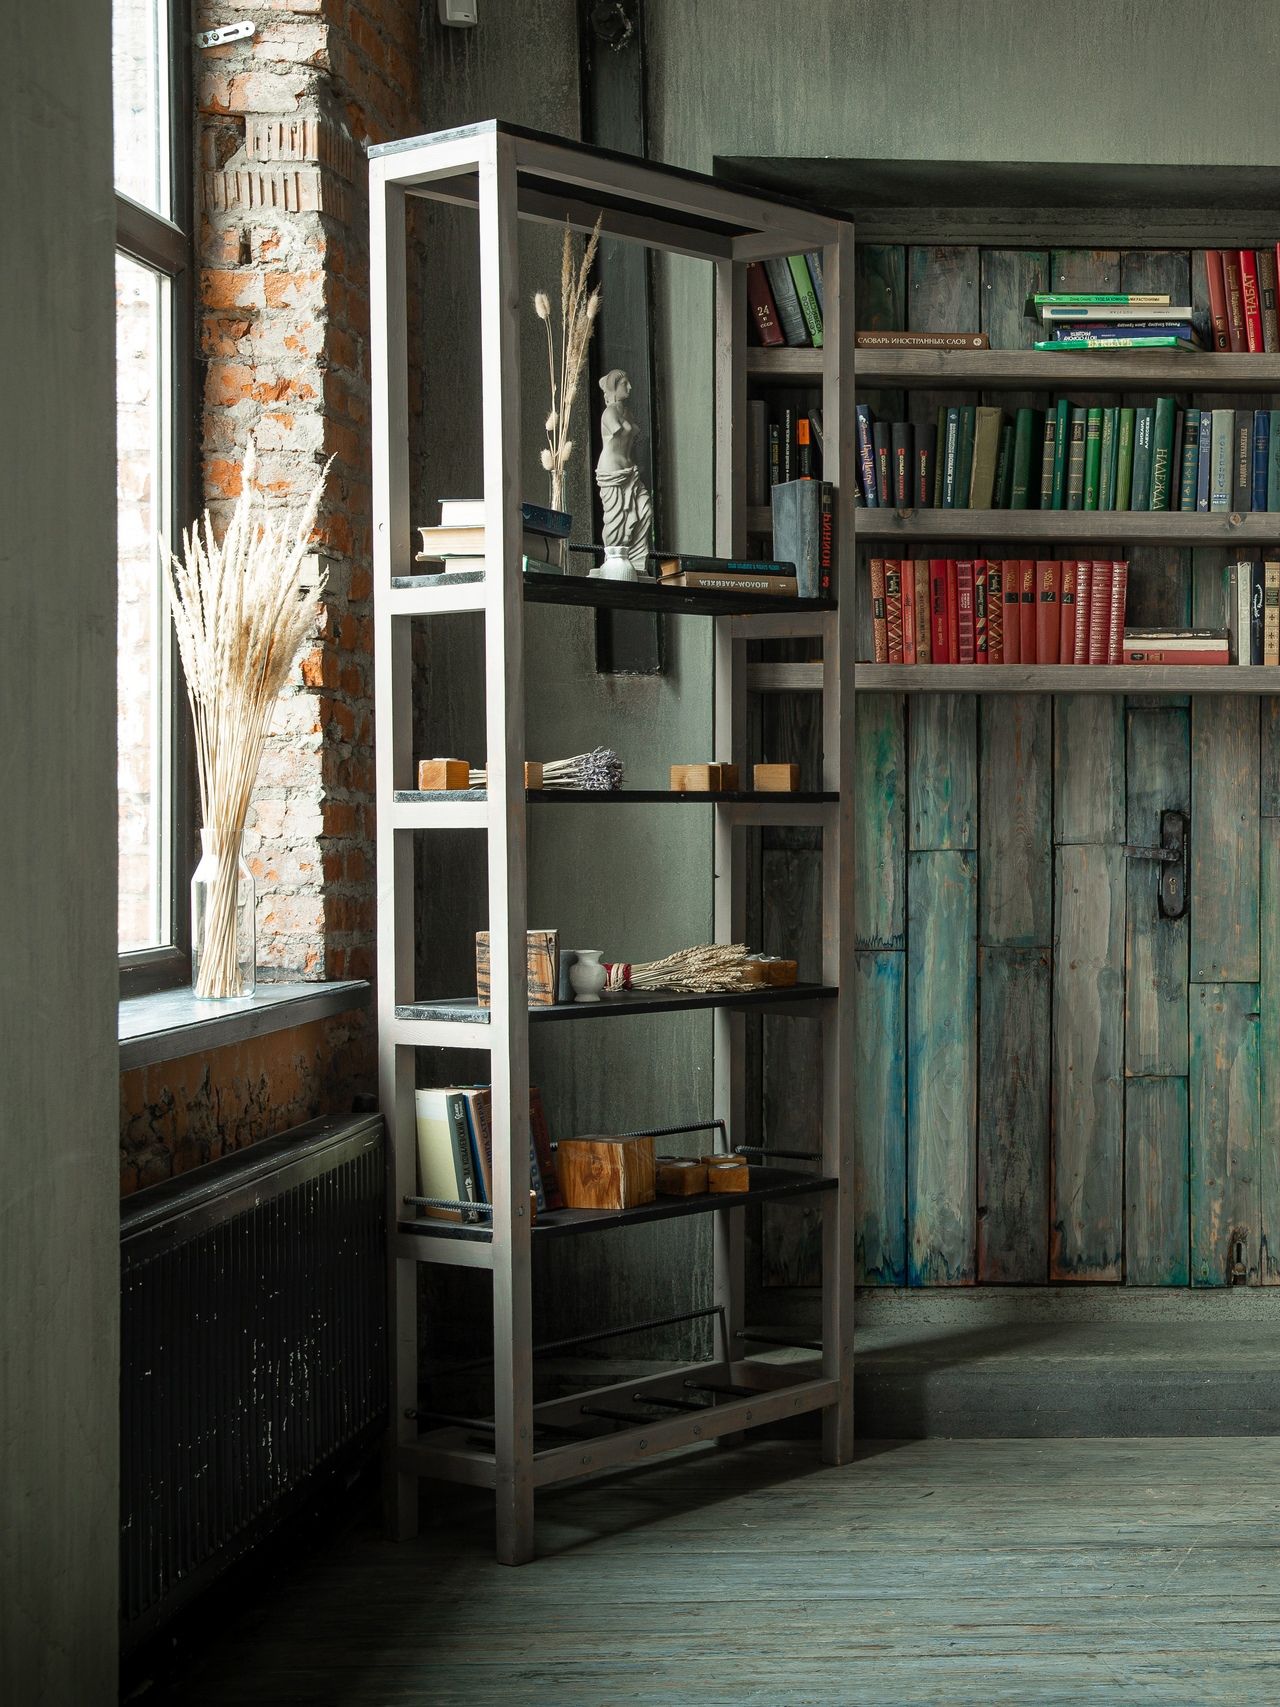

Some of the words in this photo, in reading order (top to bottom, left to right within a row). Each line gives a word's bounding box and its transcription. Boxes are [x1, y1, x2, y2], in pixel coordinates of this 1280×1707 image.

[1244, 272, 1257, 315] НАБАТ
[1088, 338, 1132, 348] БУКВАРЬ
[1153, 448, 1168, 510] НАДЕЖДА
[822, 512, 832, 567] ВОЙНИЧ
[699, 579, 769, 589] ШОЛОМ-АЛЕЙХЕМ
[476, 1101, 488, 1139] САТИРЫ
[456, 1122, 469, 1165] КОВАЛЕВСКИЙ
